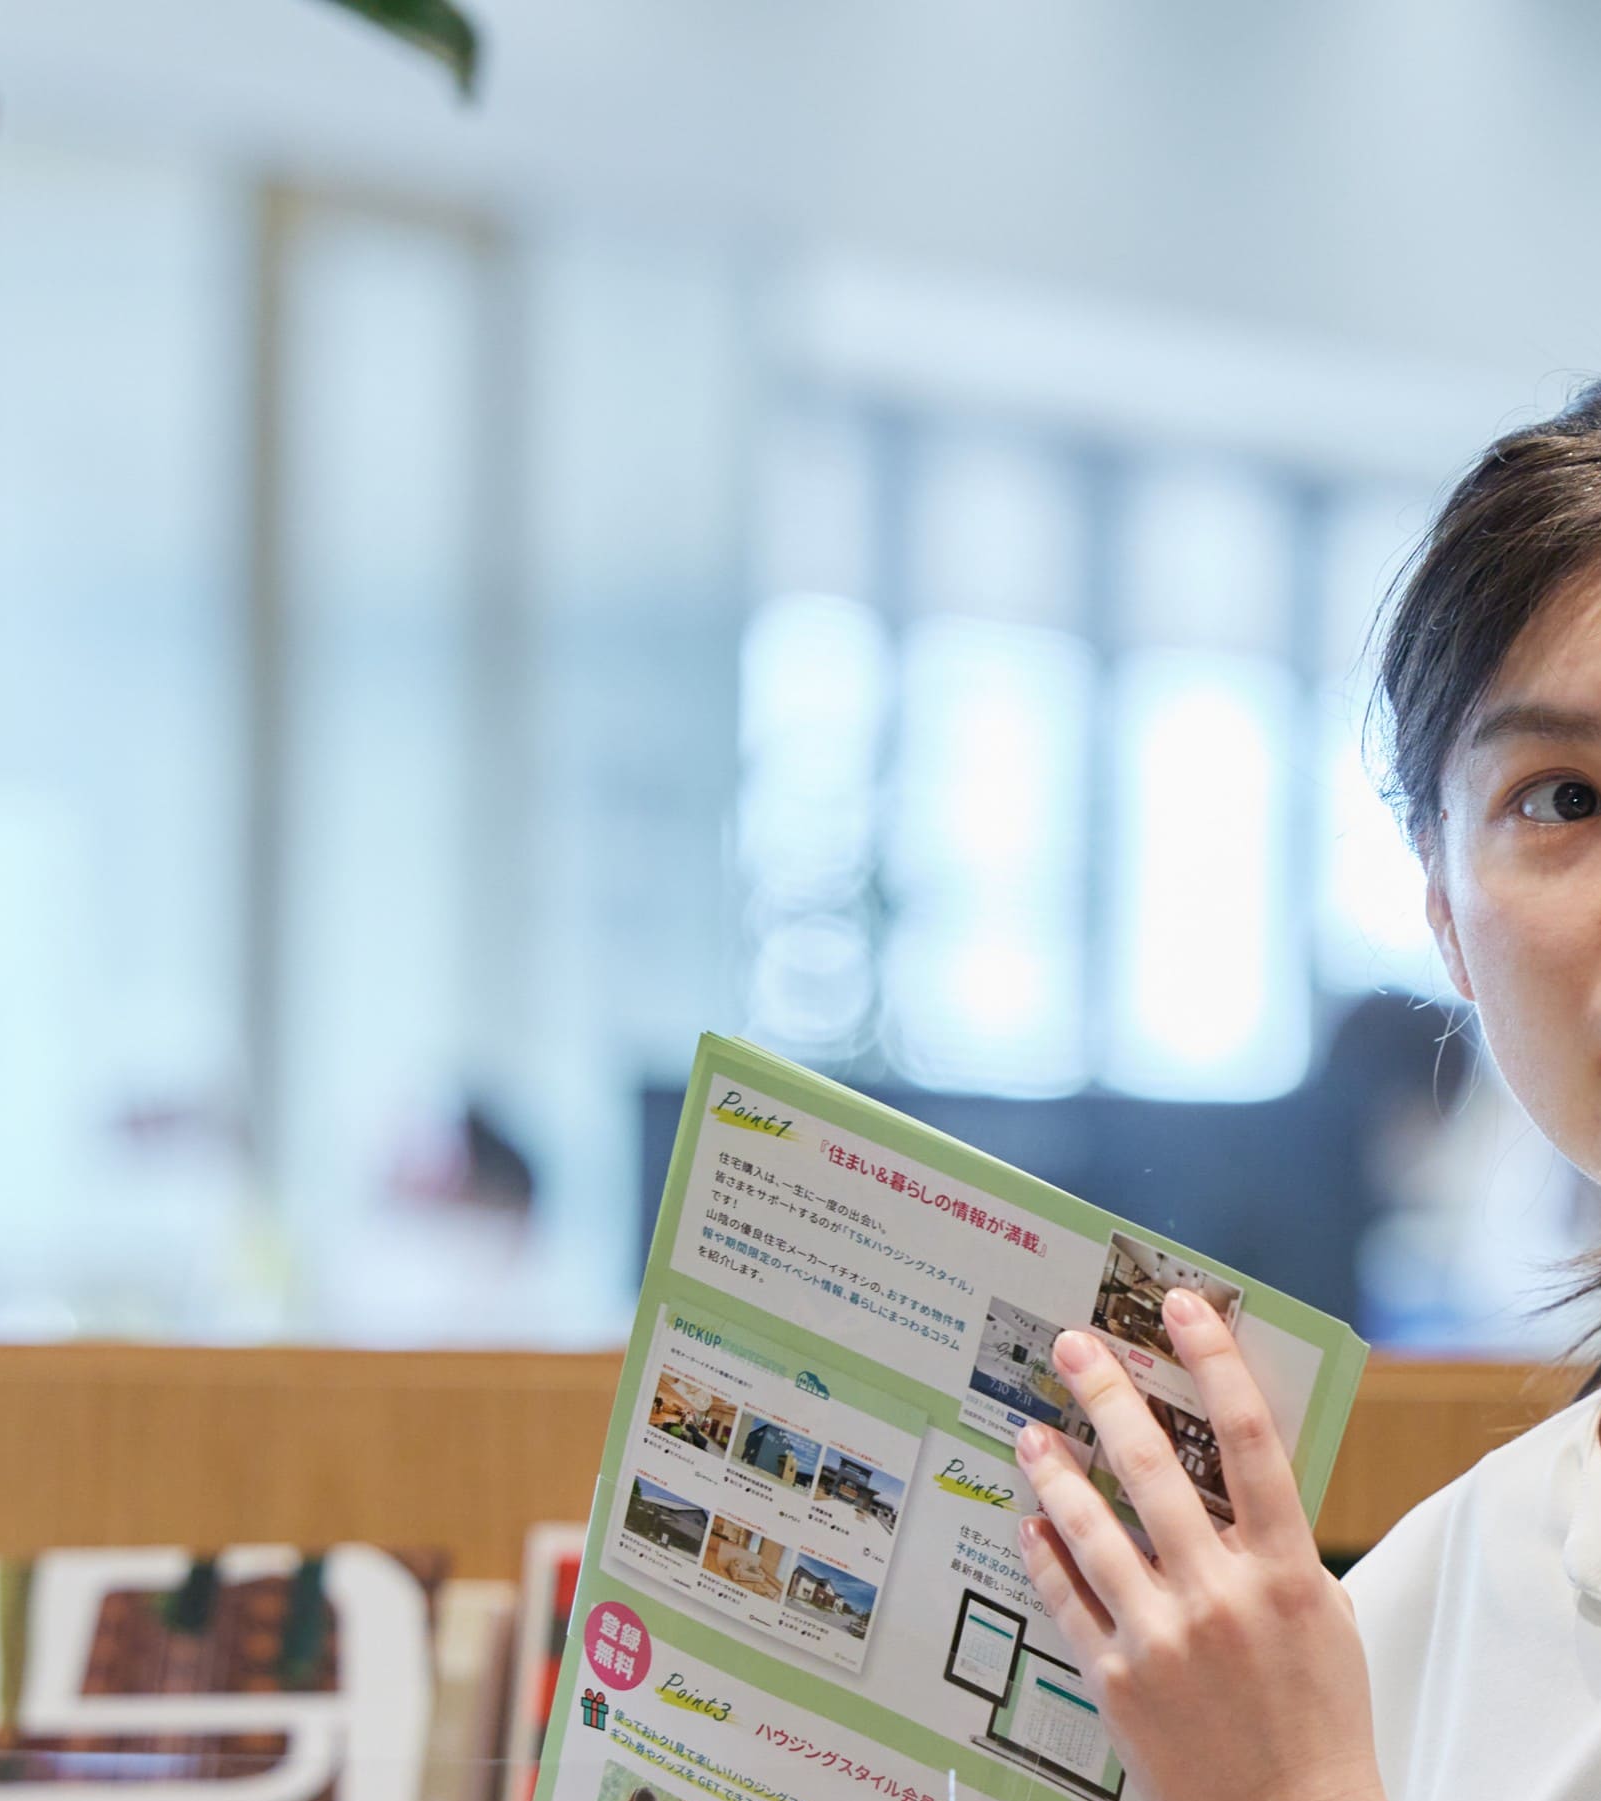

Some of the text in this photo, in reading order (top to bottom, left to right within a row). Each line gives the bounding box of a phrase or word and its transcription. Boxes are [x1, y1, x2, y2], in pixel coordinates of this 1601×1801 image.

[717, 1090, 793, 1138] Point1
[718, 1151, 888, 1236] 住宅購入は、一生に一度の出会い。
[819, 1138, 1049, 1259] 『住まい&暮らしの情報が満載』
[714, 1169, 975, 1297] 皆さまをサポートするのが「TSKハウジングスタイル」
[697, 1244, 765, 1284] を紹介します。
[701, 1225, 961, 1352] 報や期間限定のイベント情報、暮らしにまつわるコラム
[705, 1207, 966, 1334] 山陰の優良住宅メーカーイチオシの、おすすめ物件情
[673, 1317, 723, 1349] PICKUP
[940, 1458, 1015, 1509] Point2
[599, 1610, 643, 1653] 登録
[593, 1638, 636, 1681] 無料
[660, 1672, 733, 1723] Point3
[697, 1774, 721, 1794] GET
